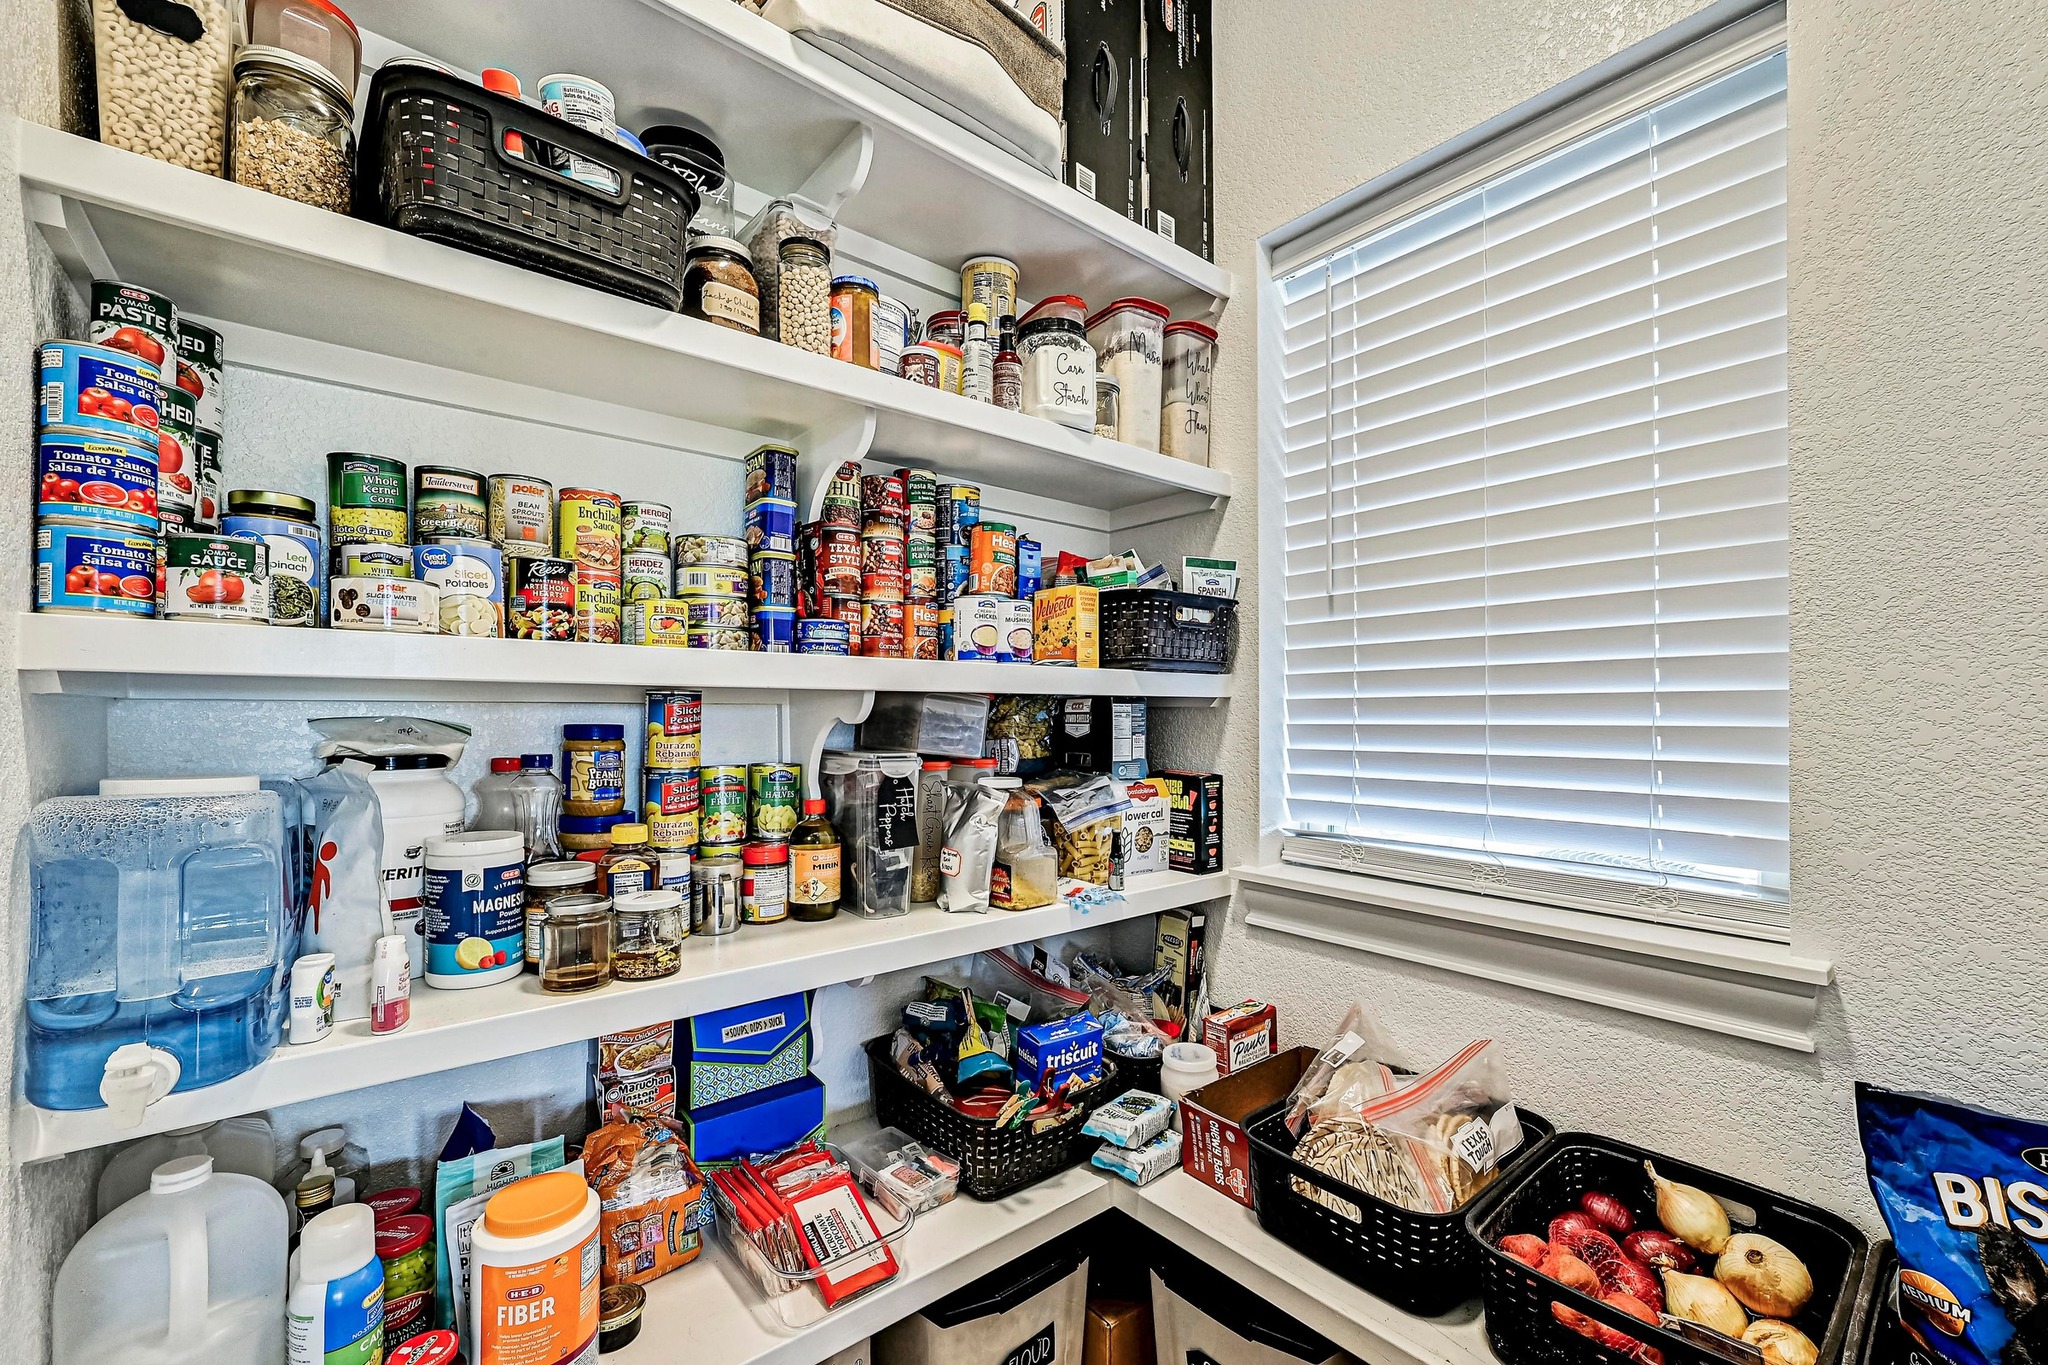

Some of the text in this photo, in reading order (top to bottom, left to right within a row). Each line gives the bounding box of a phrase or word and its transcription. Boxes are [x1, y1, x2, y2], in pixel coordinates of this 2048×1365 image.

[113, 296, 156, 313] TOMATO
[100, 303, 167, 331] PASTE
[102, 366, 154, 389] Tomato
[95, 377, 151, 401] Salsa de
[87, 444, 124, 454] EconoMax
[53, 450, 152, 475] Tomato Sauce
[745, 452, 765, 474] SPAM
[48, 462, 156, 489] Salsa de Tomate
[362, 476, 398, 486] Whole
[425, 476, 475, 491] Tendersweet
[362, 485, 399, 495] Kernel
[512, 484, 545, 497] polar
[369, 495, 395, 504] Corn
[517, 501, 540, 510] BEAN
[511, 508, 545, 518] SPROUTS
[640, 508, 669, 519] HERDEZ
[420, 518, 448, 527] Green
[880, 515, 897, 523] Roast
[357, 525, 393, 537] Grano
[593, 520, 615, 531] Sauce
[89, 543, 145, 560] Tomato
[203, 548, 237, 558] TOMATO
[829, 543, 860, 554] TEXAS
[190, 554, 247, 570] SAUCE
[286, 552, 308, 563] Leaf
[423, 553, 447, 561] Great
[82, 555, 143, 571] Salsa de
[270, 561, 308, 573] pinach
[629, 559, 664, 569] HERDEZ
[371, 567, 394, 575] WHITE
[454, 569, 488, 580] Sliced
[528, 561, 566, 577] Reese
[628, 566, 664, 575] Salsa Verde
[445, 578, 489, 589] Potatoes
[524, 583, 570, 593] ARTICHOKE
[532, 590, 563, 599] HEARTS
[1197, 587, 1227, 597] SPANISH
[594, 604, 616, 615] Sauce
[653, 605, 685, 615] EL PATO
[1035, 594, 1074, 621] Velveeta
[818, 622, 845, 631] StarKist
[812, 643, 840, 651] StarKist
[675, 706, 701, 716] Sliced
[1076, 714, 1090, 723] SHELLS
[655, 742, 696, 750] Durazno
[655, 749, 700, 759] Rebanado
[588, 767, 623, 779] PEANUT
[588, 777, 623, 790] BUTTER
[672, 784, 698, 795] Sliced
[765, 790, 795, 799] HALVES
[1127, 785, 1157, 796] pastabilities
[711, 797, 741, 806] FRUIT
[921, 780, 943, 817] Short
[895, 787, 914, 822] Hatch
[1124, 807, 1164, 822] lower cal
[653, 821, 693, 829] Durazno
[878, 803, 898, 847] Peppers
[653, 828, 697, 838] Rebanado
[813, 861, 839, 871] MIRIN
[382, 866, 423, 881] ERIT
[499, 907, 522, 918] Powder
[484, 926, 508, 935] Supports
[749, 1022, 763, 1034] DIPS
[768, 1015, 783, 1029] SUCH
[634, 1027, 658, 1042] Chicken
[1233, 1032, 1267, 1065] Panko
[1018, 1047, 1038, 1068] triscuit
[1046, 1041, 1099, 1069] triscuit
[619, 1074, 673, 1094] Maruchan
[622, 1087, 659, 1103] Instant
[1461, 1126, 1488, 1152] TEXAS
[1467, 1137, 1493, 1165] TOUGH
[814, 1213, 841, 1258] MICROWAVE
[825, 1215, 847, 1250] POPCORN
[804, 1224, 825, 1260] KIRKLAND
[1901, 1281, 1971, 1323] MEDIUM
[497, 1297, 556, 1327] FIBER
